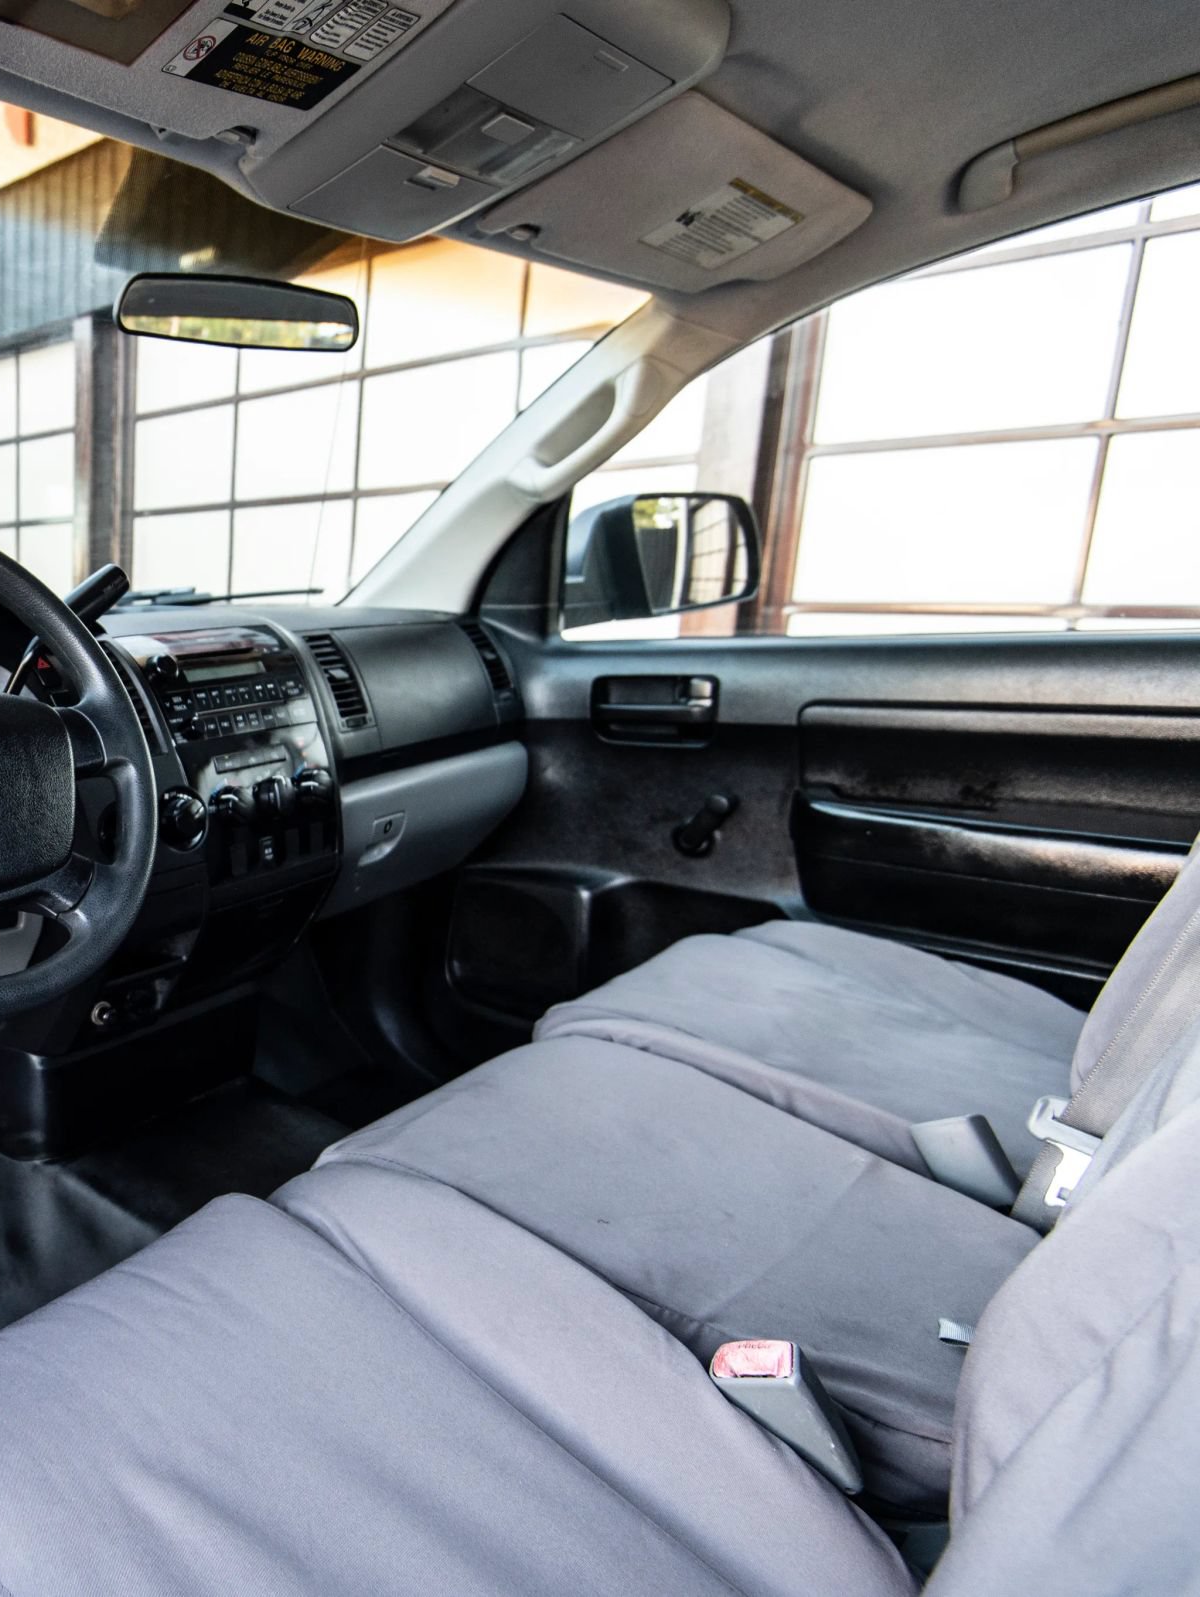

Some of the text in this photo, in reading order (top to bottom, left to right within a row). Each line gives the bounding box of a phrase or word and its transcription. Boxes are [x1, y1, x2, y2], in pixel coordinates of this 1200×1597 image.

[246, 32, 270, 45] AIR
[268, 37, 296, 53] BAG
[297, 47, 346, 72] WARNING
